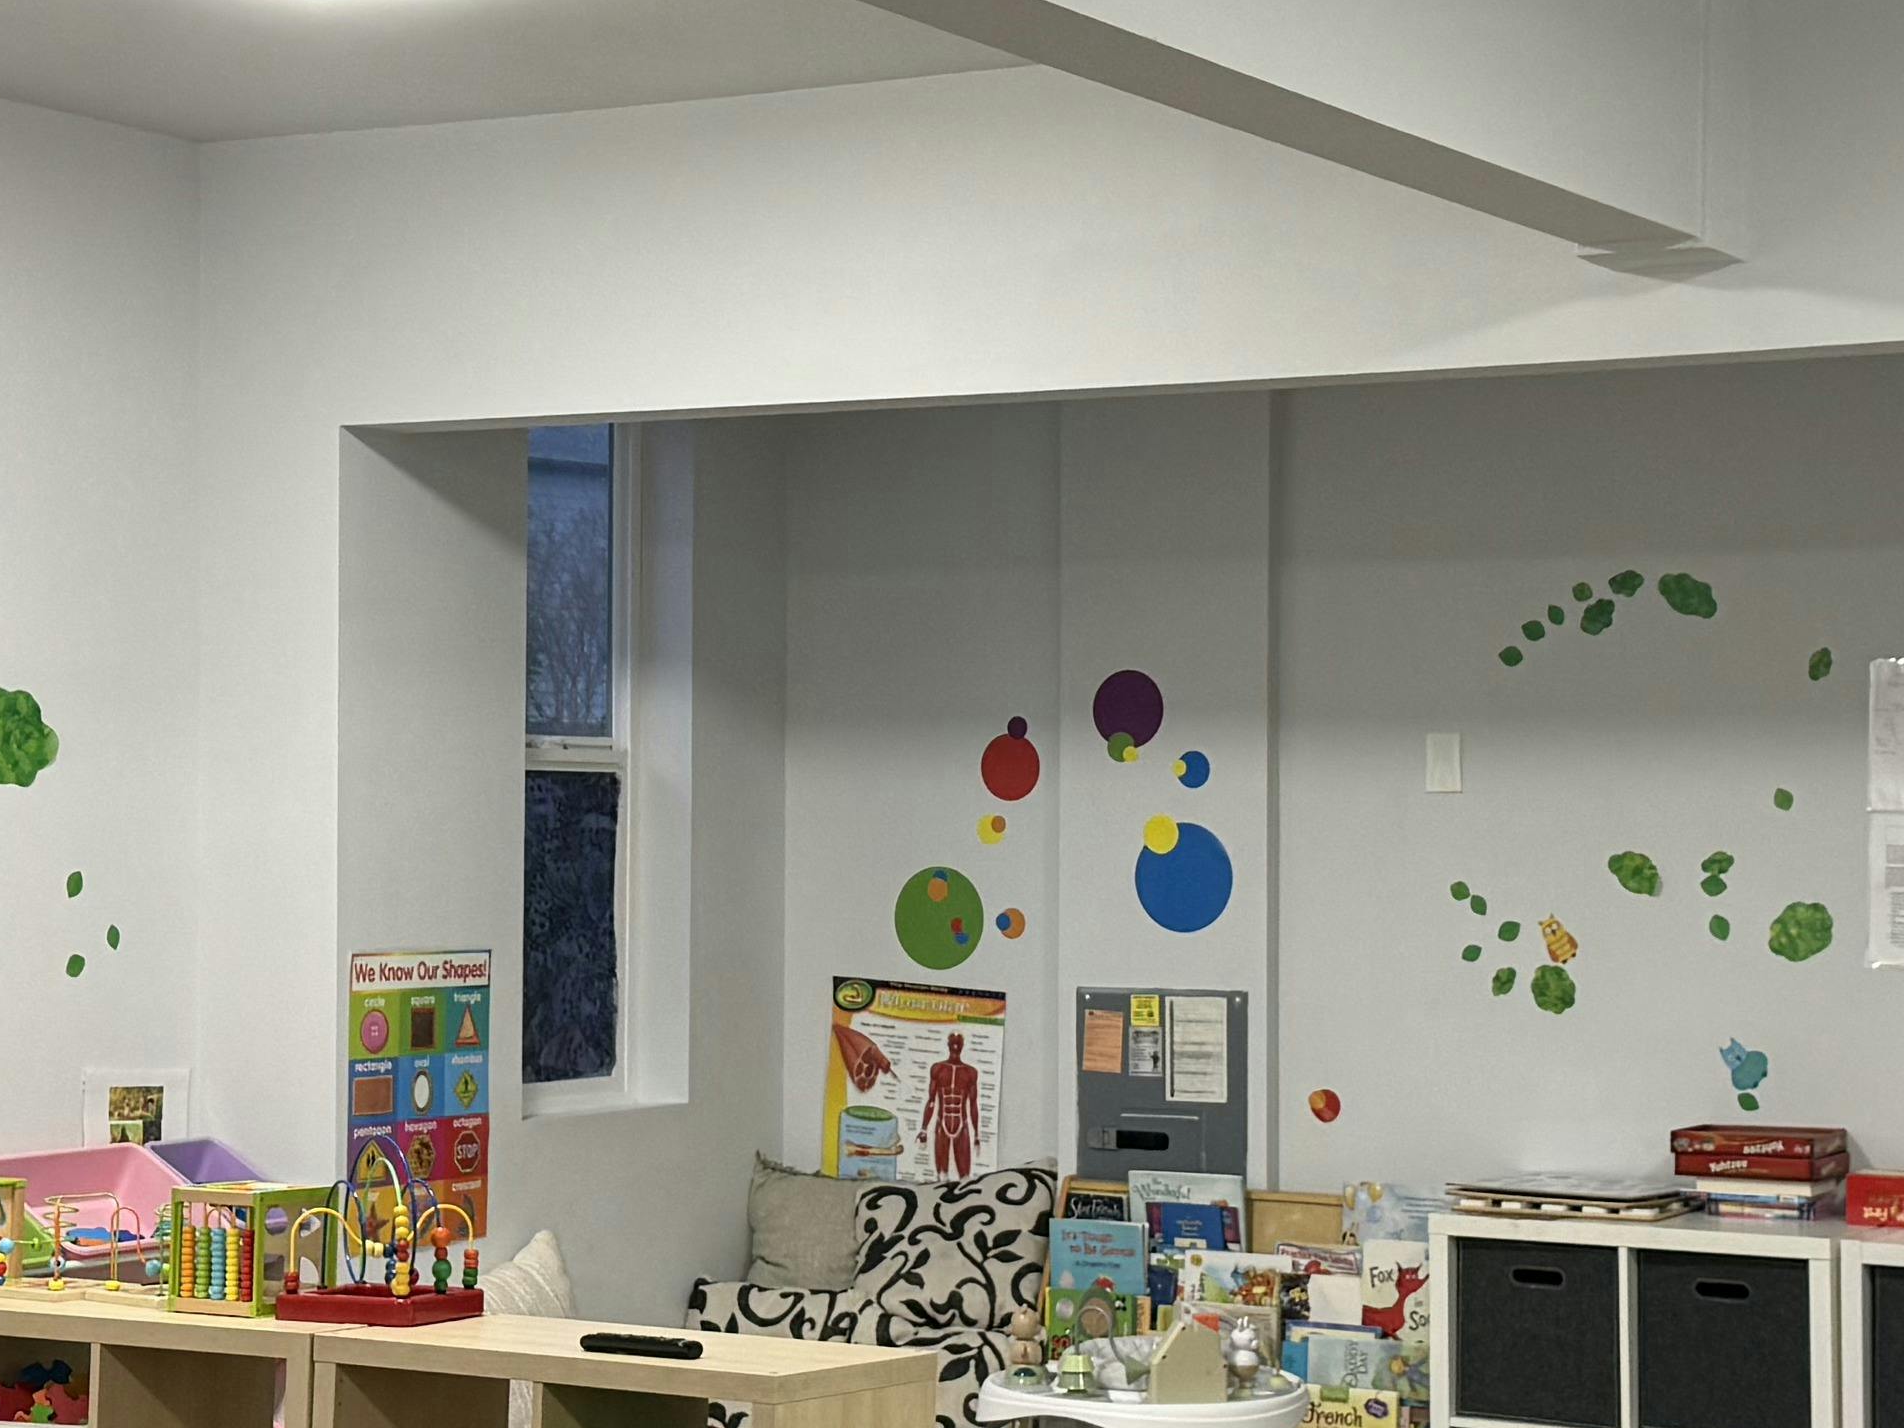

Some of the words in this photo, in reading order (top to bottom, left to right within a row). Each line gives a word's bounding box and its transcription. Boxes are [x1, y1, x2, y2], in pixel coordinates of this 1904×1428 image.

[354, 962, 376, 983] We
[379, 962, 414, 982] Know
[417, 960, 440, 981] Our
[442, 958, 487, 983] Shapes!
[456, 1143, 480, 1159] STOP
[1369, 1266, 1394, 1289] Fox
[1302, 1401, 1363, 1428] French
